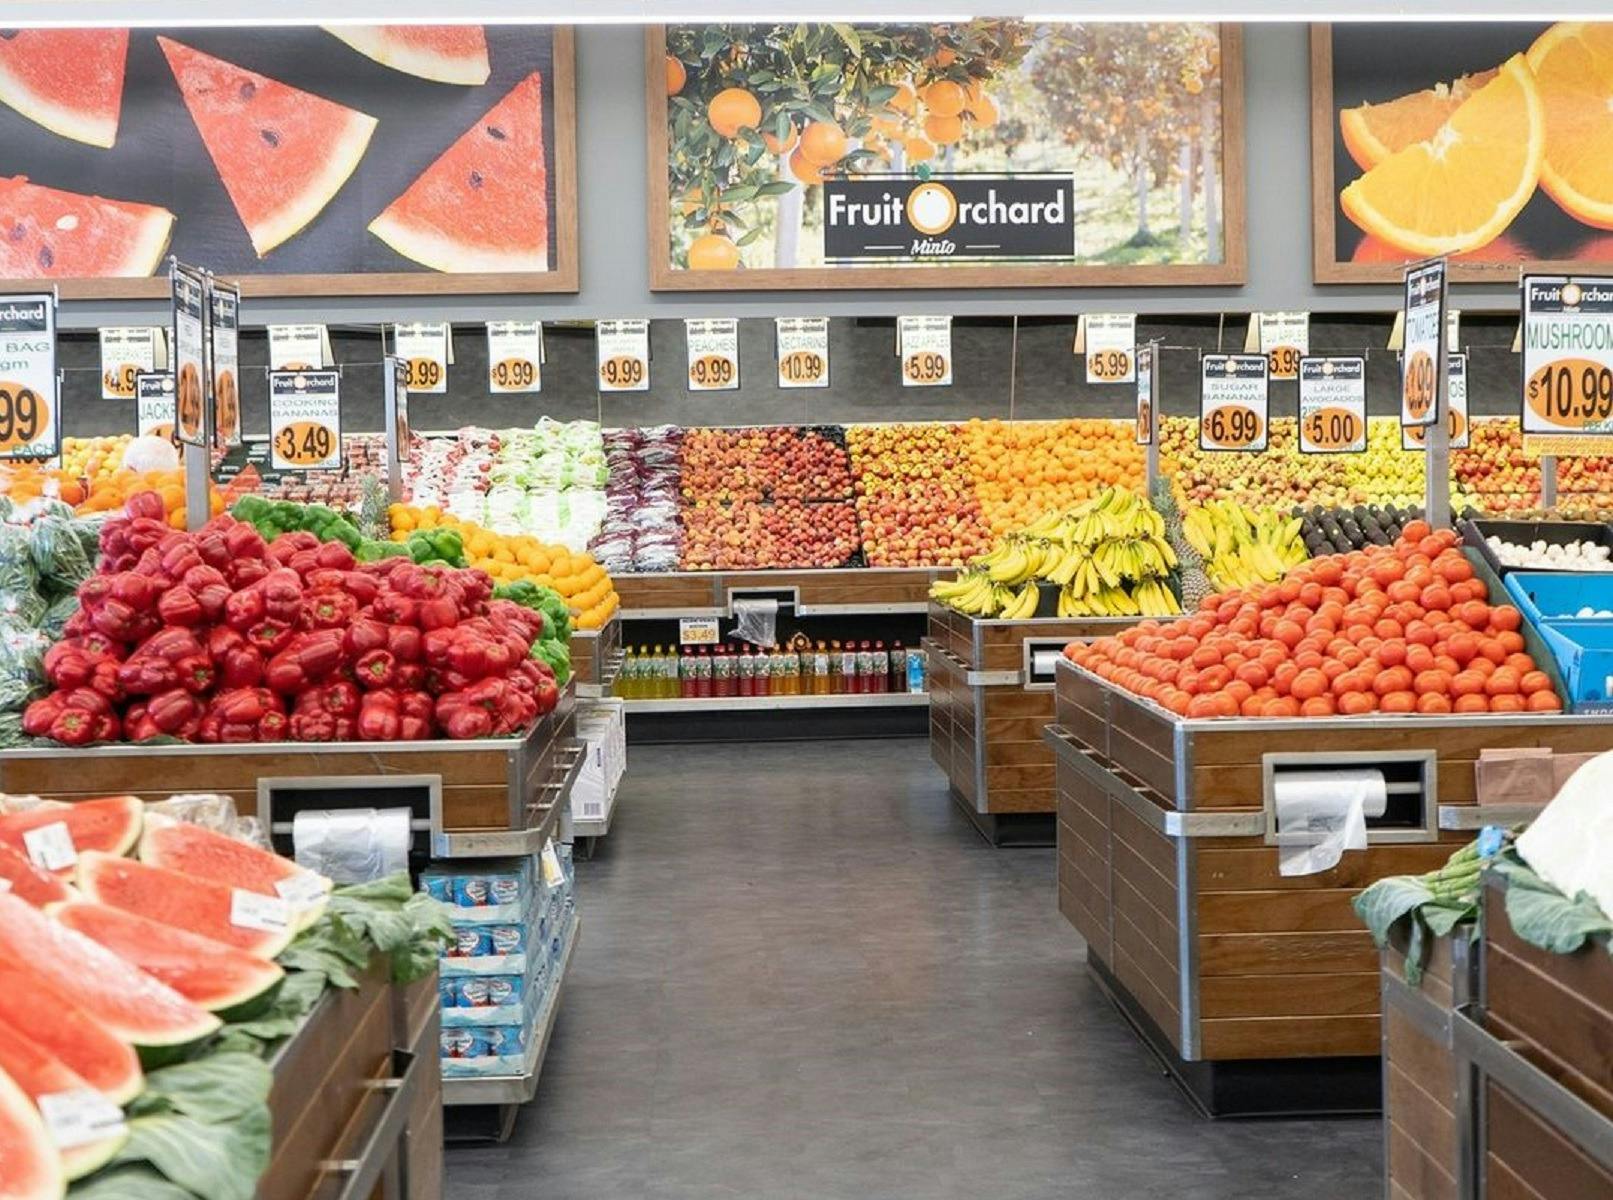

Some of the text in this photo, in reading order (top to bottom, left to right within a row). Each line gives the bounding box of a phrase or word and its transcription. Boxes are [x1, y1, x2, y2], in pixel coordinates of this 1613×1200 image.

[829, 192, 904, 226] Fruit
[910, 238, 957, 256] Minto
[1532, 287, 1561, 302] Fruit
[6, 342, 51, 353] BAG
[492, 360, 533, 386] $9.99
[601, 358, 642, 384] $9.99
[690, 359, 732, 384] $9.99
[780, 354, 821, 380] $10.99
[905, 354, 945, 379] $5.99
[1089, 351, 1128, 377] $5.99
[1206, 361, 1224, 371] Fruit
[1203, 393, 1265, 401] BANANAS
[1211, 383, 1258, 391] SUGAR
[1529, 366, 1613, 419] $10.99
[272, 399, 338, 407] COOKING
[272, 409, 338, 417] BANANAS
[1203, 409, 1257, 441] $6.99
[1305, 414, 1353, 442] $5.00
[273, 425, 330, 459] $3.49
